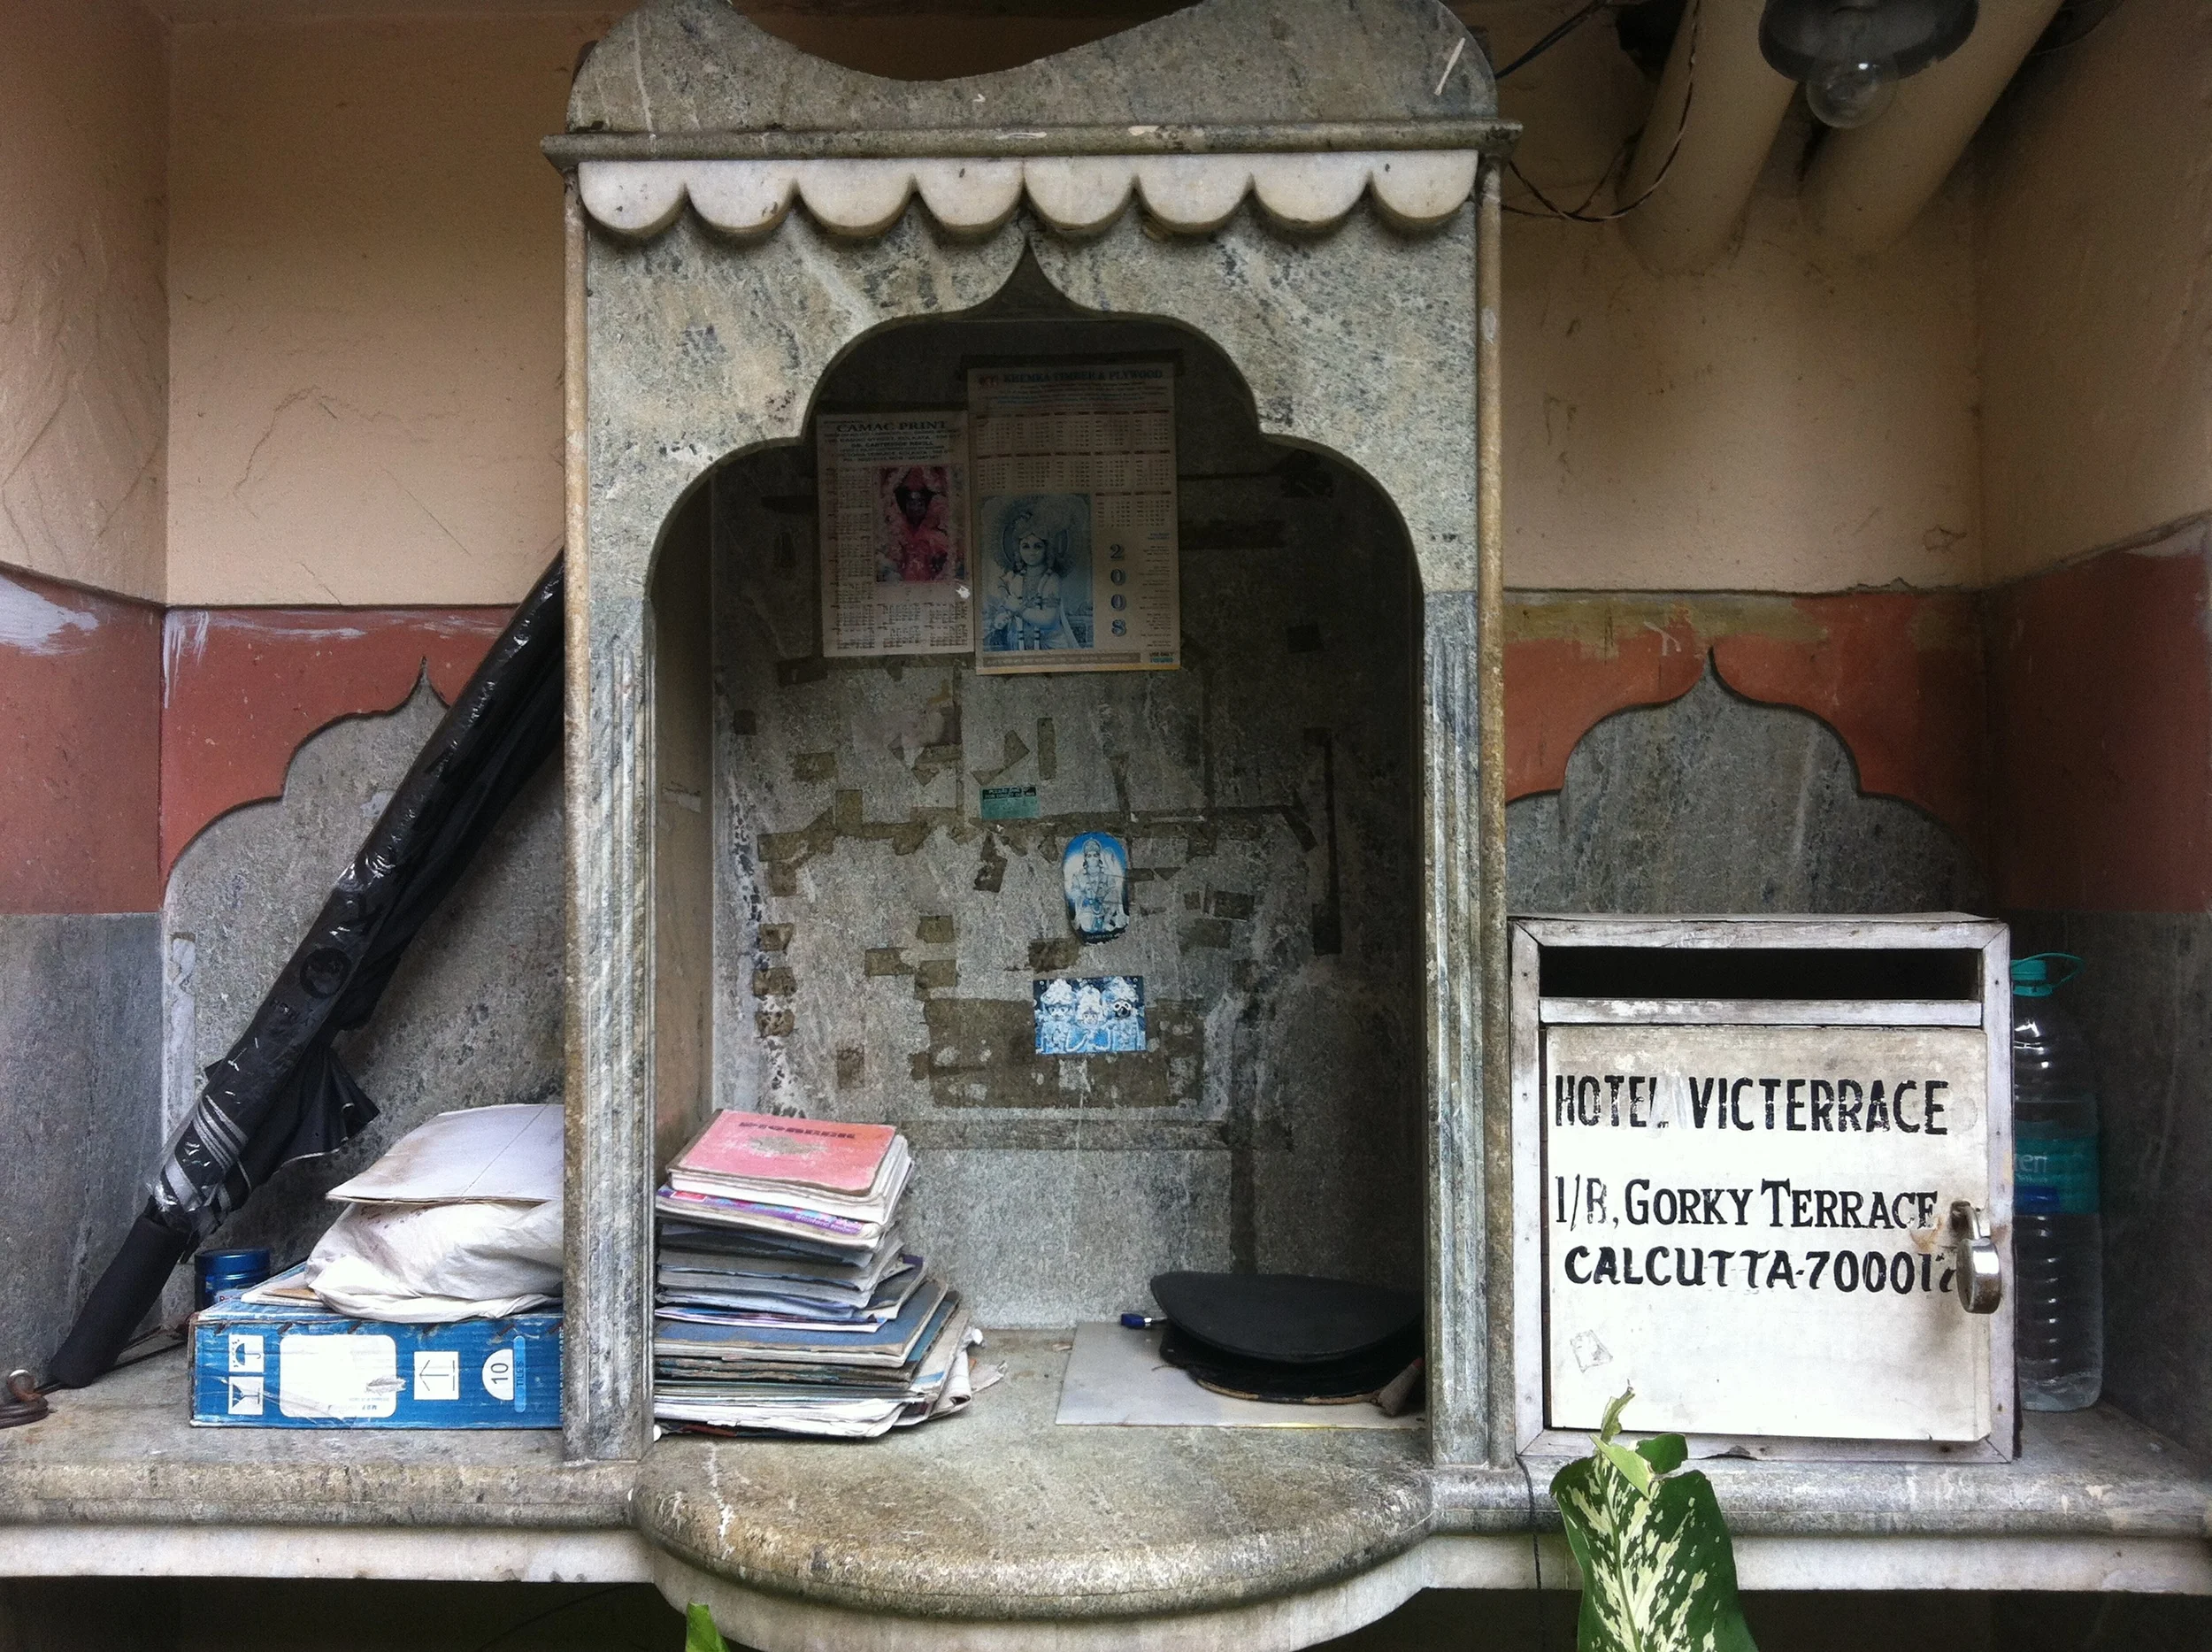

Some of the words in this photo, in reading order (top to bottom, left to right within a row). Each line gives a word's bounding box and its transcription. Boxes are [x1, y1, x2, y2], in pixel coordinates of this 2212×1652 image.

[1109, 369, 1164, 380] PLYWOOD
[836, 423, 894, 433] CAMAC
[900, 420, 948, 430] PRINT
[1688, 1077, 1949, 1136] VICTERRACE
[1624, 1179, 1752, 1226] GORKY
[1762, 1179, 1939, 1231] TERRACE
[490, 1362, 510, 1385] 10
[516, 1360, 526, 1387] TILES
